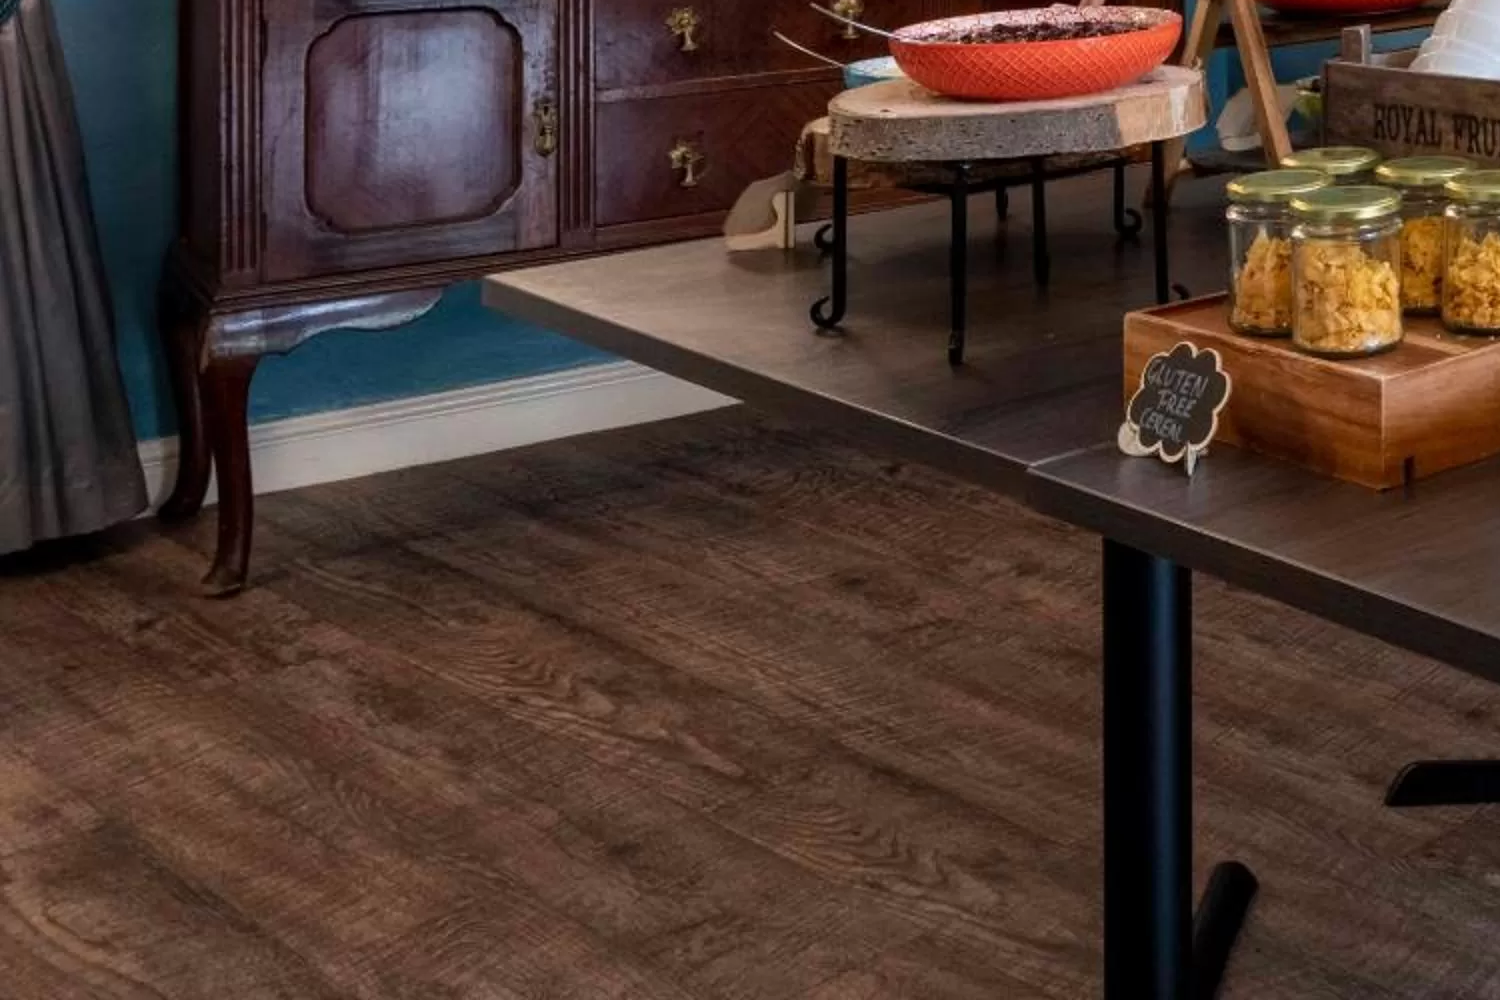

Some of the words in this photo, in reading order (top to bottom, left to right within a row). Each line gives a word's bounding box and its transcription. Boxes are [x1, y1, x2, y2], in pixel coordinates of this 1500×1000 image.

[1373, 103, 1442, 146] ROYAL
[1148, 359, 1209, 399] GLUTEN
[1158, 388, 1198, 418] FREE
